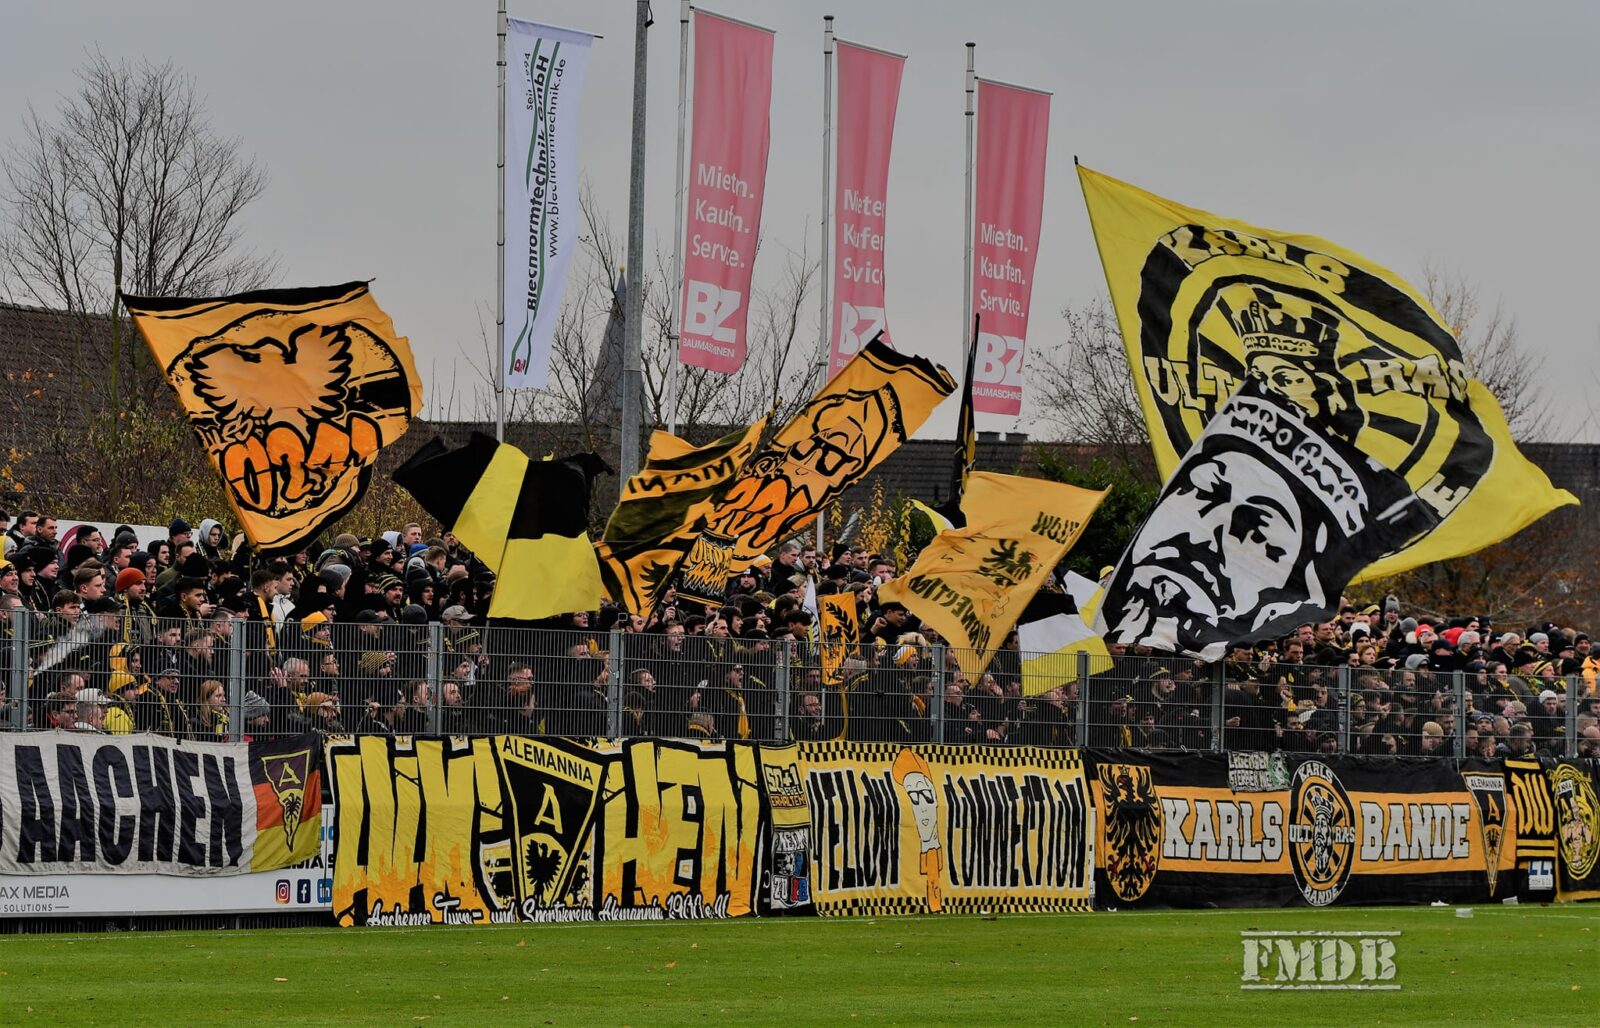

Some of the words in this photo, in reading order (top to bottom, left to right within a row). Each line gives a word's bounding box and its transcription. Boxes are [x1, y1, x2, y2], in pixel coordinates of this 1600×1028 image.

[981, 223, 1028, 252] Mieten.
[980, 255, 1026, 285] Kaufen.
[1160, 226, 1351, 294] KARLS
[683, 279, 741, 344] BZ
[980, 288, 1025, 318] Service.
[973, 331, 1024, 386] BZ
[503, 736, 593, 785] ALEMANNIA
[1298, 763, 1334, 784] KARLS
[1470, 779, 1503, 788] ALEMANNIA
[14, 744, 244, 868] AACHEN
[534, 782, 563, 834] A
[806, 769, 900, 891] YELLOW
[943, 774, 1086, 889] CONNECTION
[1161, 797, 1284, 862] KARLS
[1360, 801, 1470, 861] BANDE
[23, 885, 70, 899] MEDIA
[1303, 882, 1339, 904] BANDE
[3, 903, 53, 913] SOLUTIONS
[491, 904, 515, 924] und
